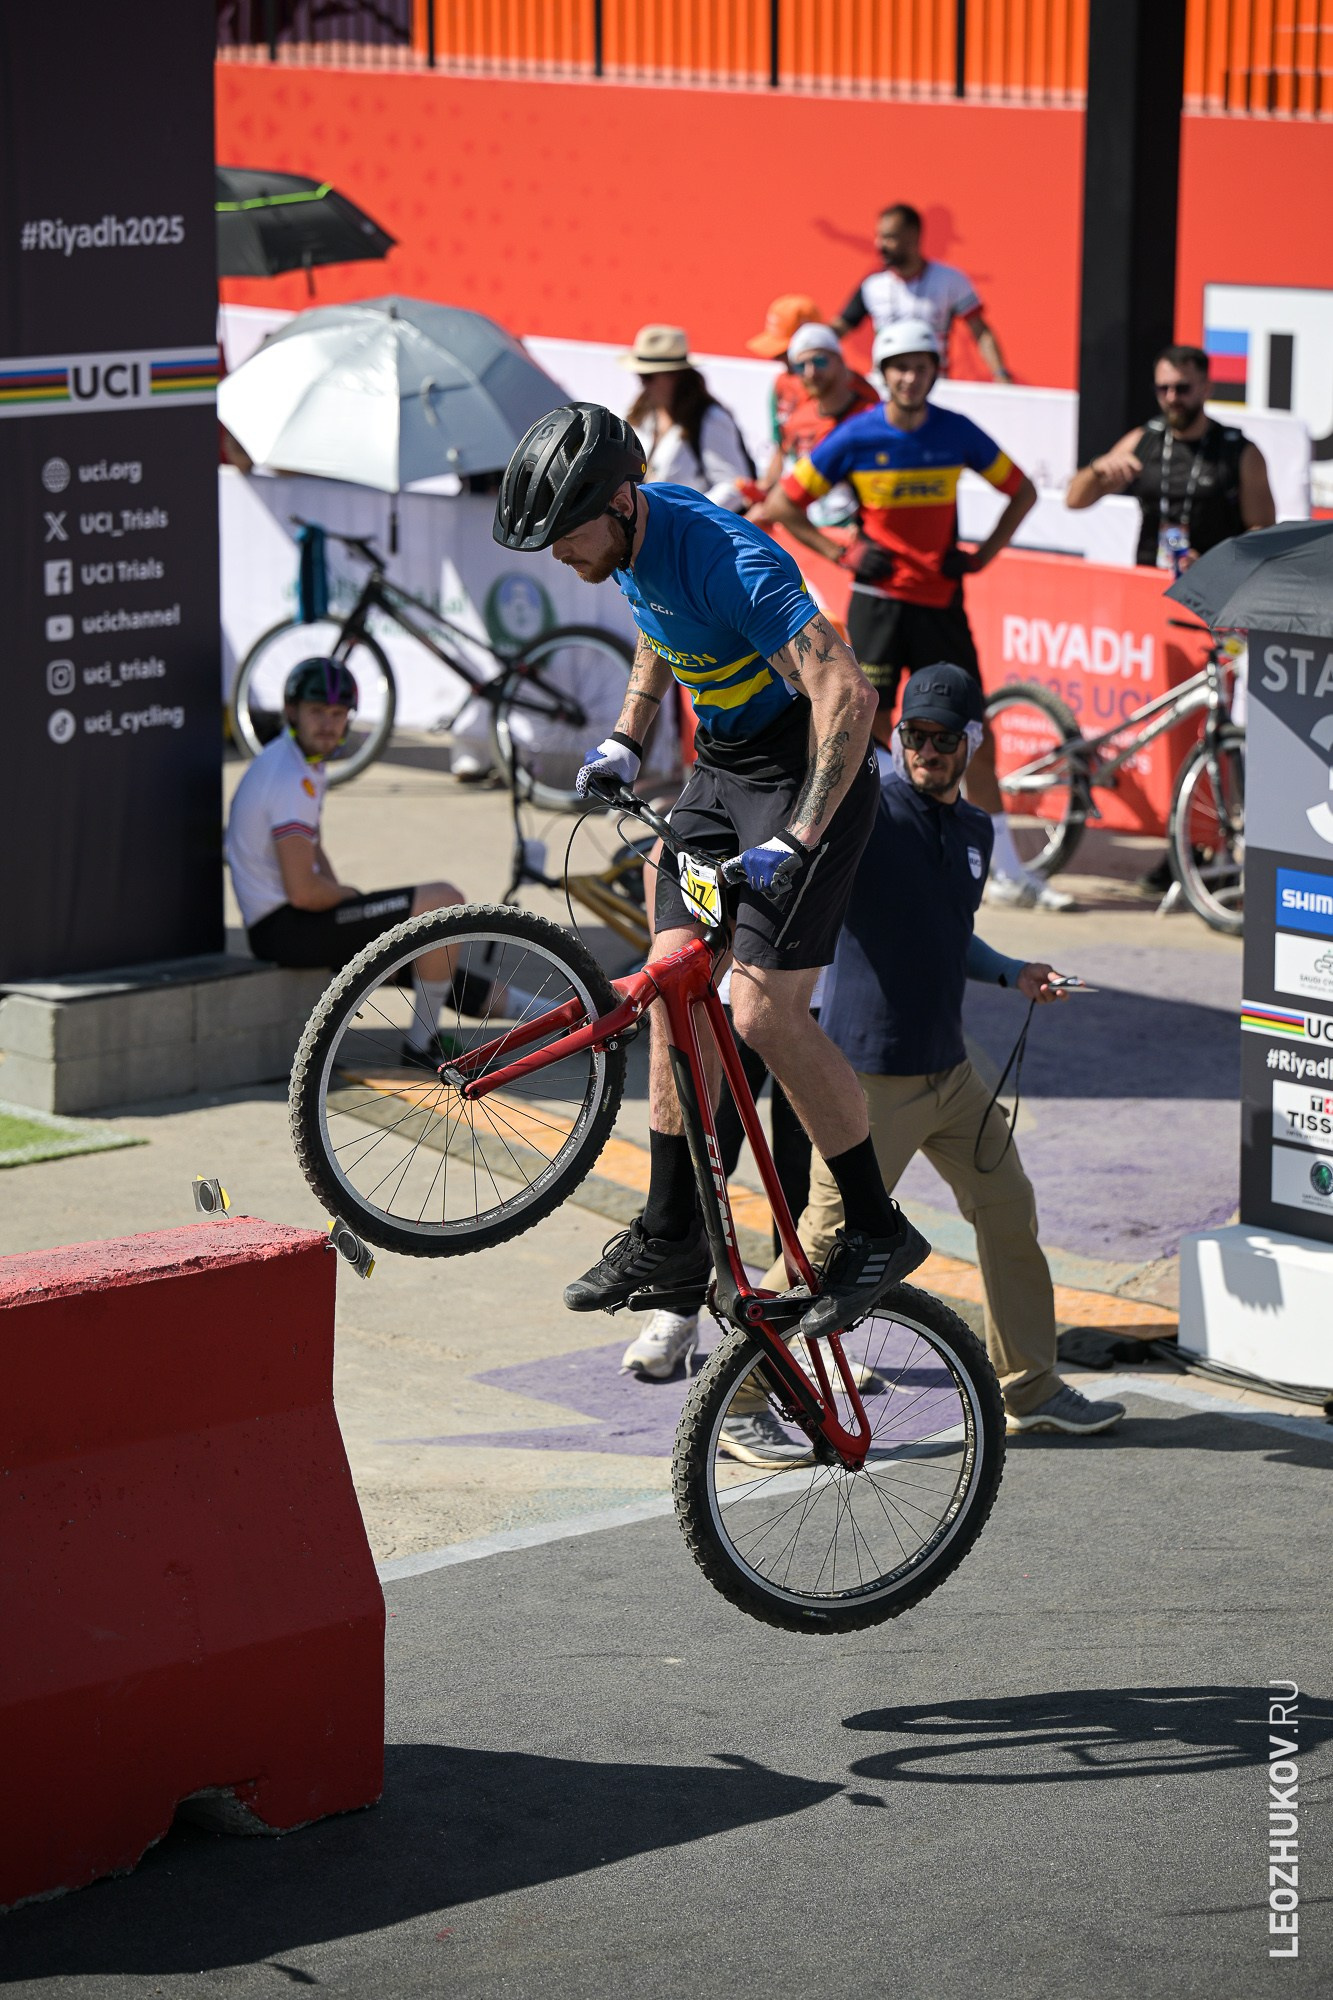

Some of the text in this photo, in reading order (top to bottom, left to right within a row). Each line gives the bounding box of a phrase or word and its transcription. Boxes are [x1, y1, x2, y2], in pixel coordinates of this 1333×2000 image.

[21, 215, 185, 257] #Riyadh2025
[73, 363, 141, 399] UCI
[79, 459, 142, 484] uci.org
[79, 507, 169, 537] UCI_Trials
[81, 557, 165, 585] UCI Trials
[82, 603, 181, 634] ucichannel
[1002, 614, 1154, 681] RIYADH
[83, 656, 165, 687] uci_trials
[84, 703, 184, 736] uci_cycling
